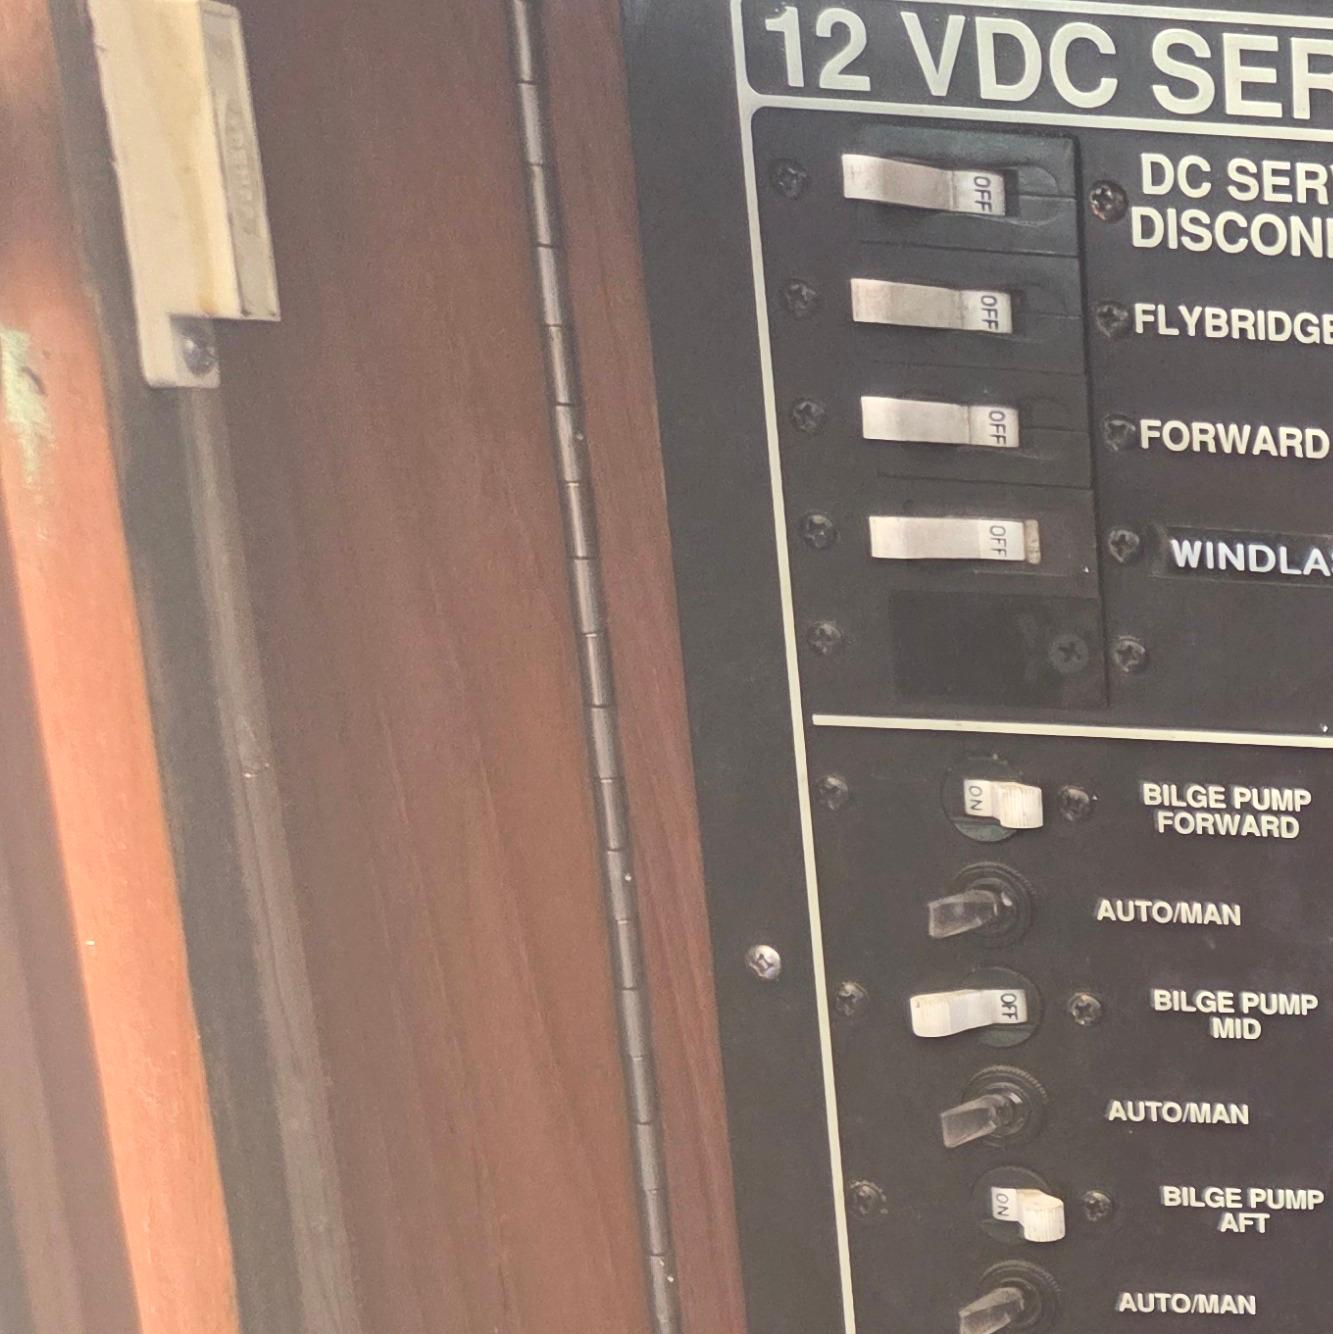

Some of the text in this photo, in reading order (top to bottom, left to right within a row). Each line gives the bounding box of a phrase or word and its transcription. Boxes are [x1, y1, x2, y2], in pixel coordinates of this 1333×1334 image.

[765, 6, 870, 91] 12
[900, 11, 1117, 108] VDC
[974, 176, 992, 212] OFF
[1141, 153, 1211, 198] DC
[981, 296, 998, 330] OFF
[1140, 419, 1329, 458] FORWARD
[1097, 899, 1240, 925] AUTO/MAN
